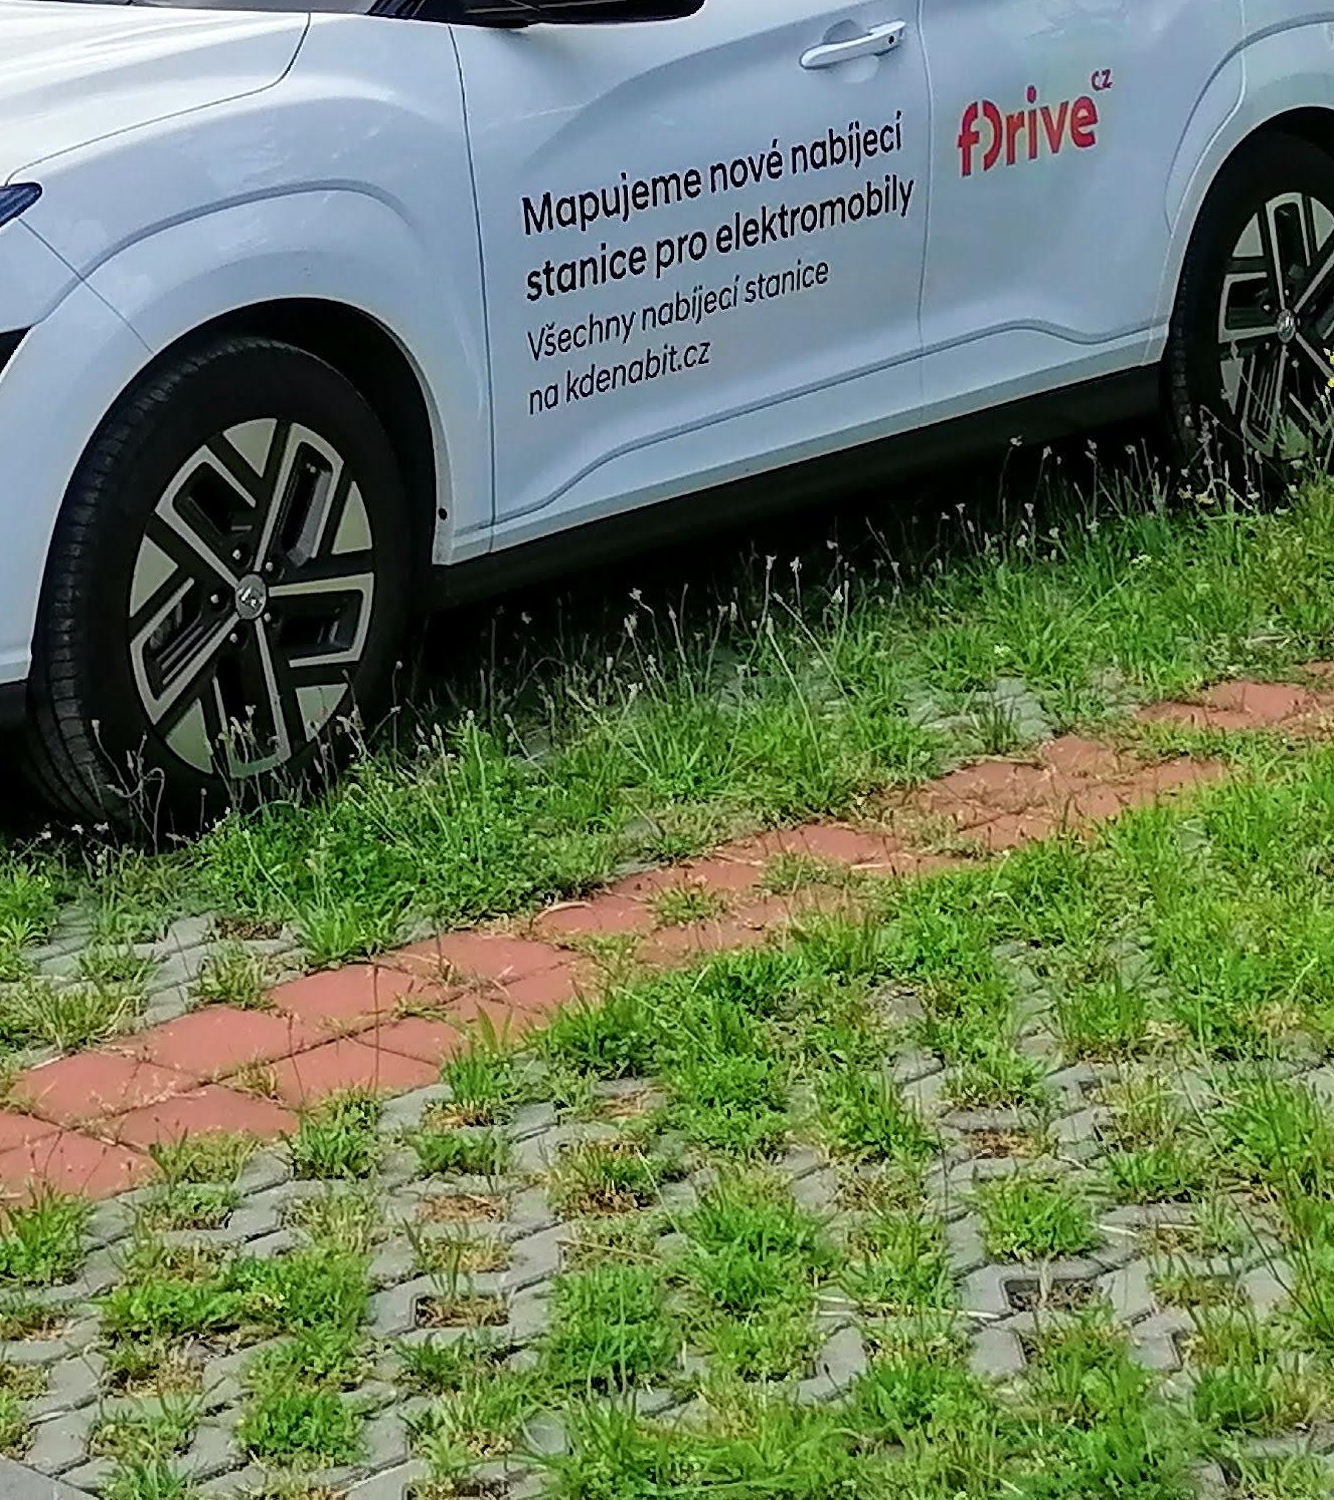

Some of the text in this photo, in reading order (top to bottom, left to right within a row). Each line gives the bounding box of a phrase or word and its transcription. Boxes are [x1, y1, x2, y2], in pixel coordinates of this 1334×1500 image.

[521, 109, 903, 236] Mapujeme nové nabíjecí
[526, 173, 915, 302] stanice pro elektromobily
[527, 258, 829, 362] Všechny nabíjecí stanice
[528, 341, 711, 415] na kdenabit.cz
